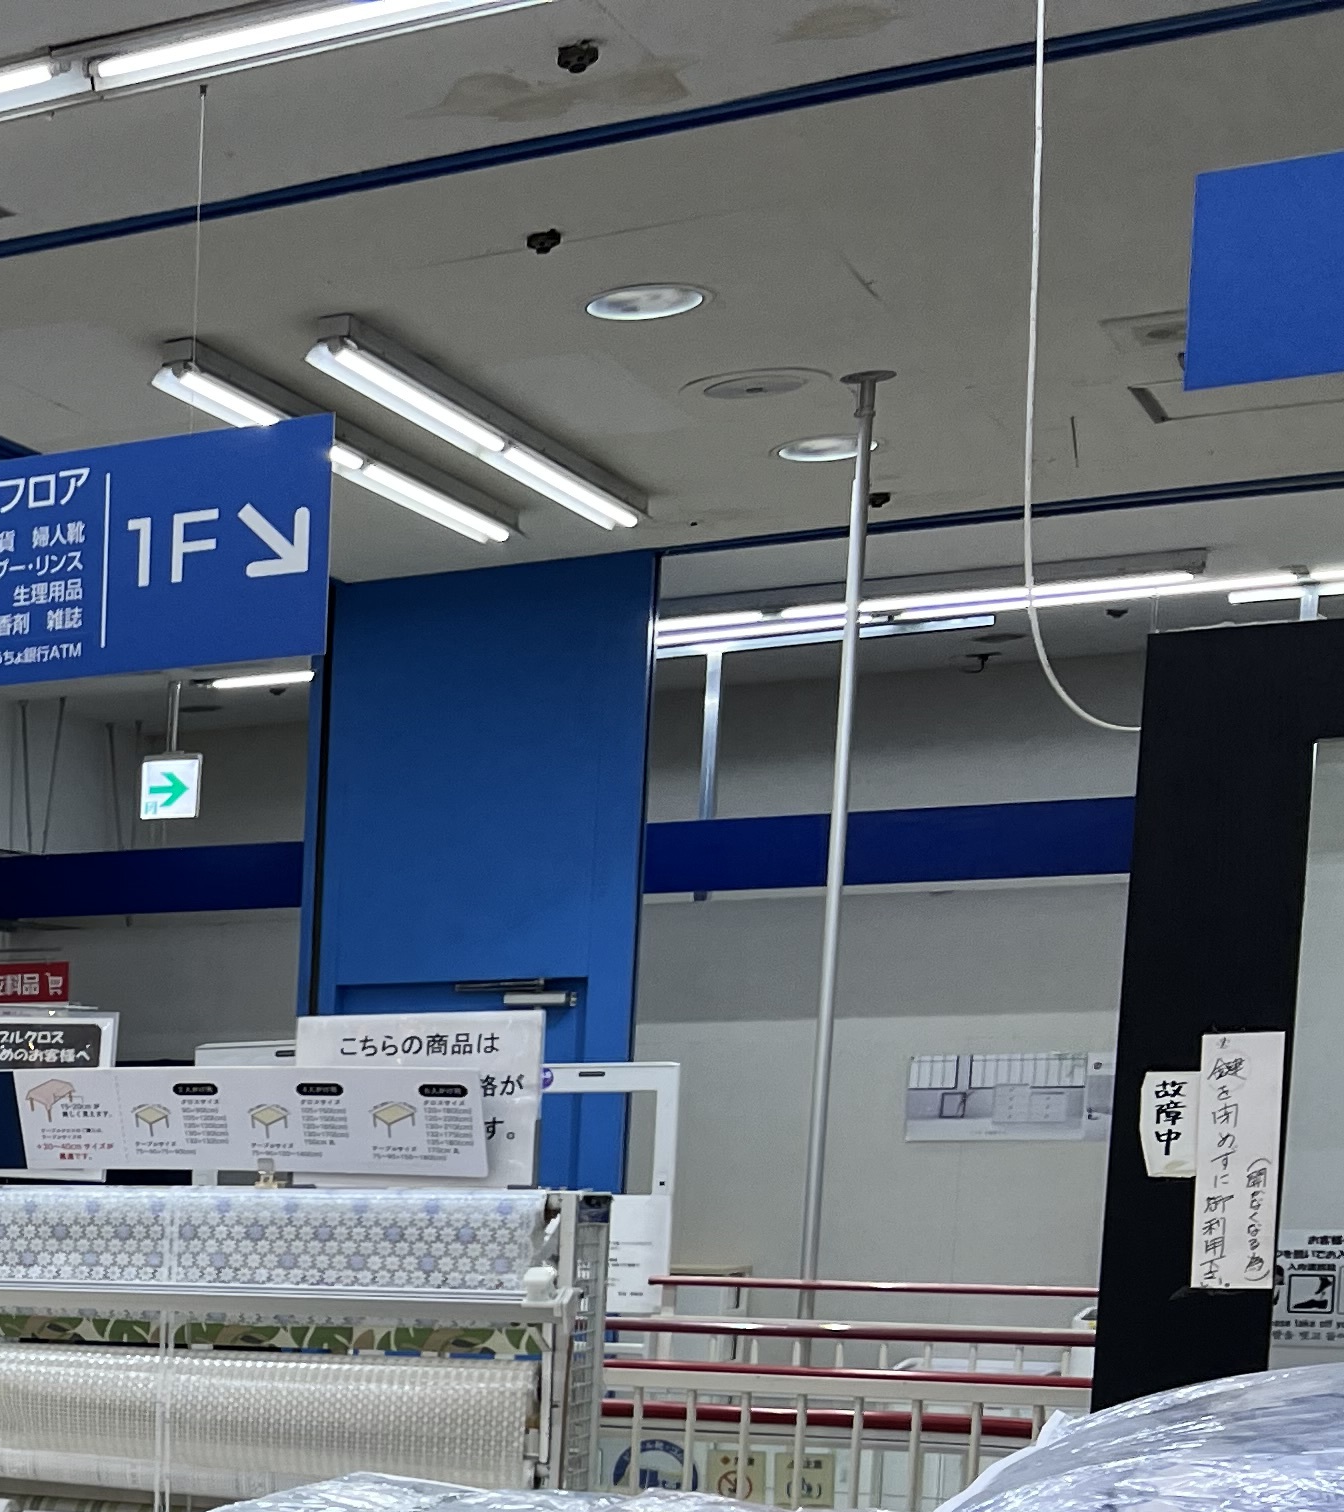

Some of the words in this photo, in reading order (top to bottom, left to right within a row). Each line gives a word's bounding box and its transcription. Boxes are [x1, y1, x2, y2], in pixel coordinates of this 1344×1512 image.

[32, 521, 86, 549] 婦人靴
[128, 508, 219, 588] 1F
[13, 578, 83, 607] 生理用品
[46, 606, 83, 631] 雑誌
[340, 1033, 500, 1057] こちらの商品は
[1155, 1080, 1188, 1156] 故障中
